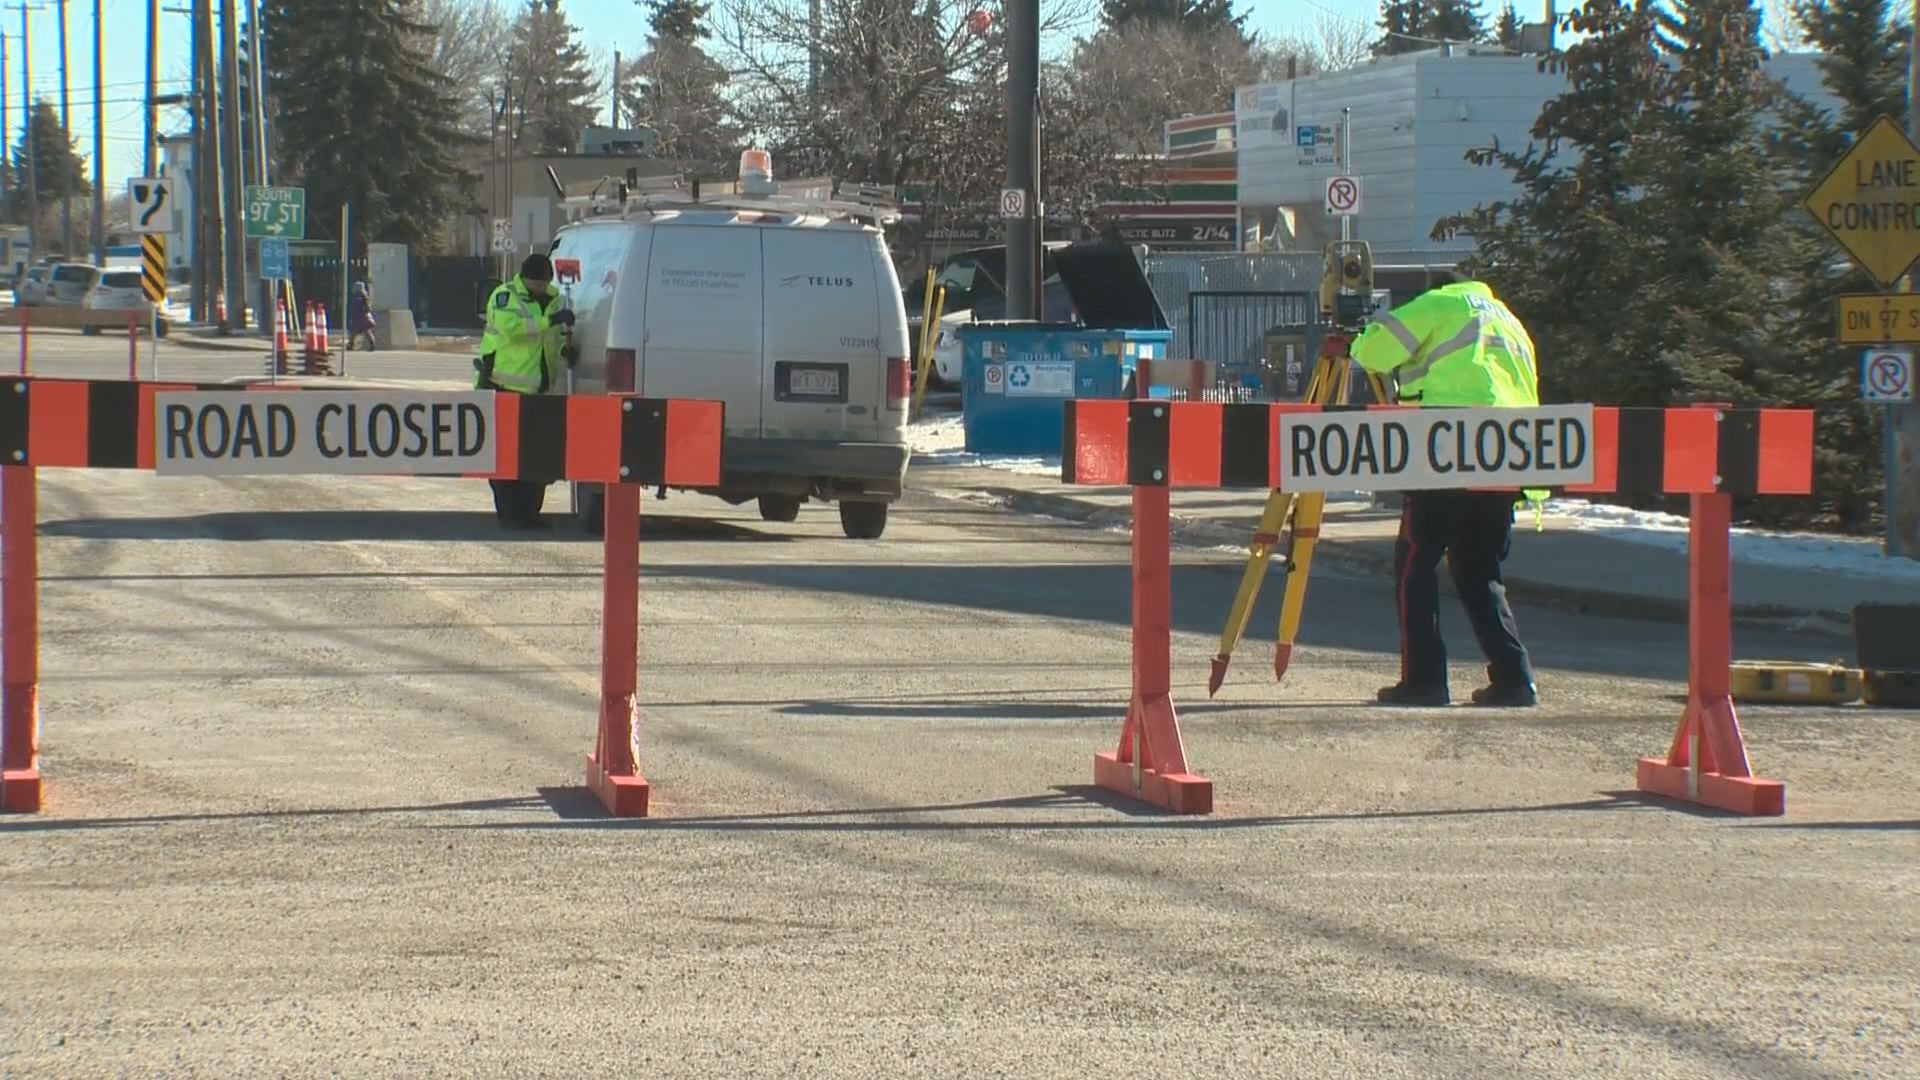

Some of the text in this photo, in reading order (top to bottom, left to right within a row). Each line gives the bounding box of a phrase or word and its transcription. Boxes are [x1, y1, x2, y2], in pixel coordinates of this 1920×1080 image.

[1856, 159, 1917, 187] LANE
[256, 189, 292, 202] SOUTH
[250, 202, 301, 224] 97 ST
[1152, 228, 1177, 238] BLITZ
[807, 276, 854, 288] TELUS
[1847, 310, 1871, 330] ON
[1879, 310, 1900, 329] 97
[166, 402, 487, 459] ROAD CLOSED
[1291, 417, 1587, 477] ROAD CLOSED
